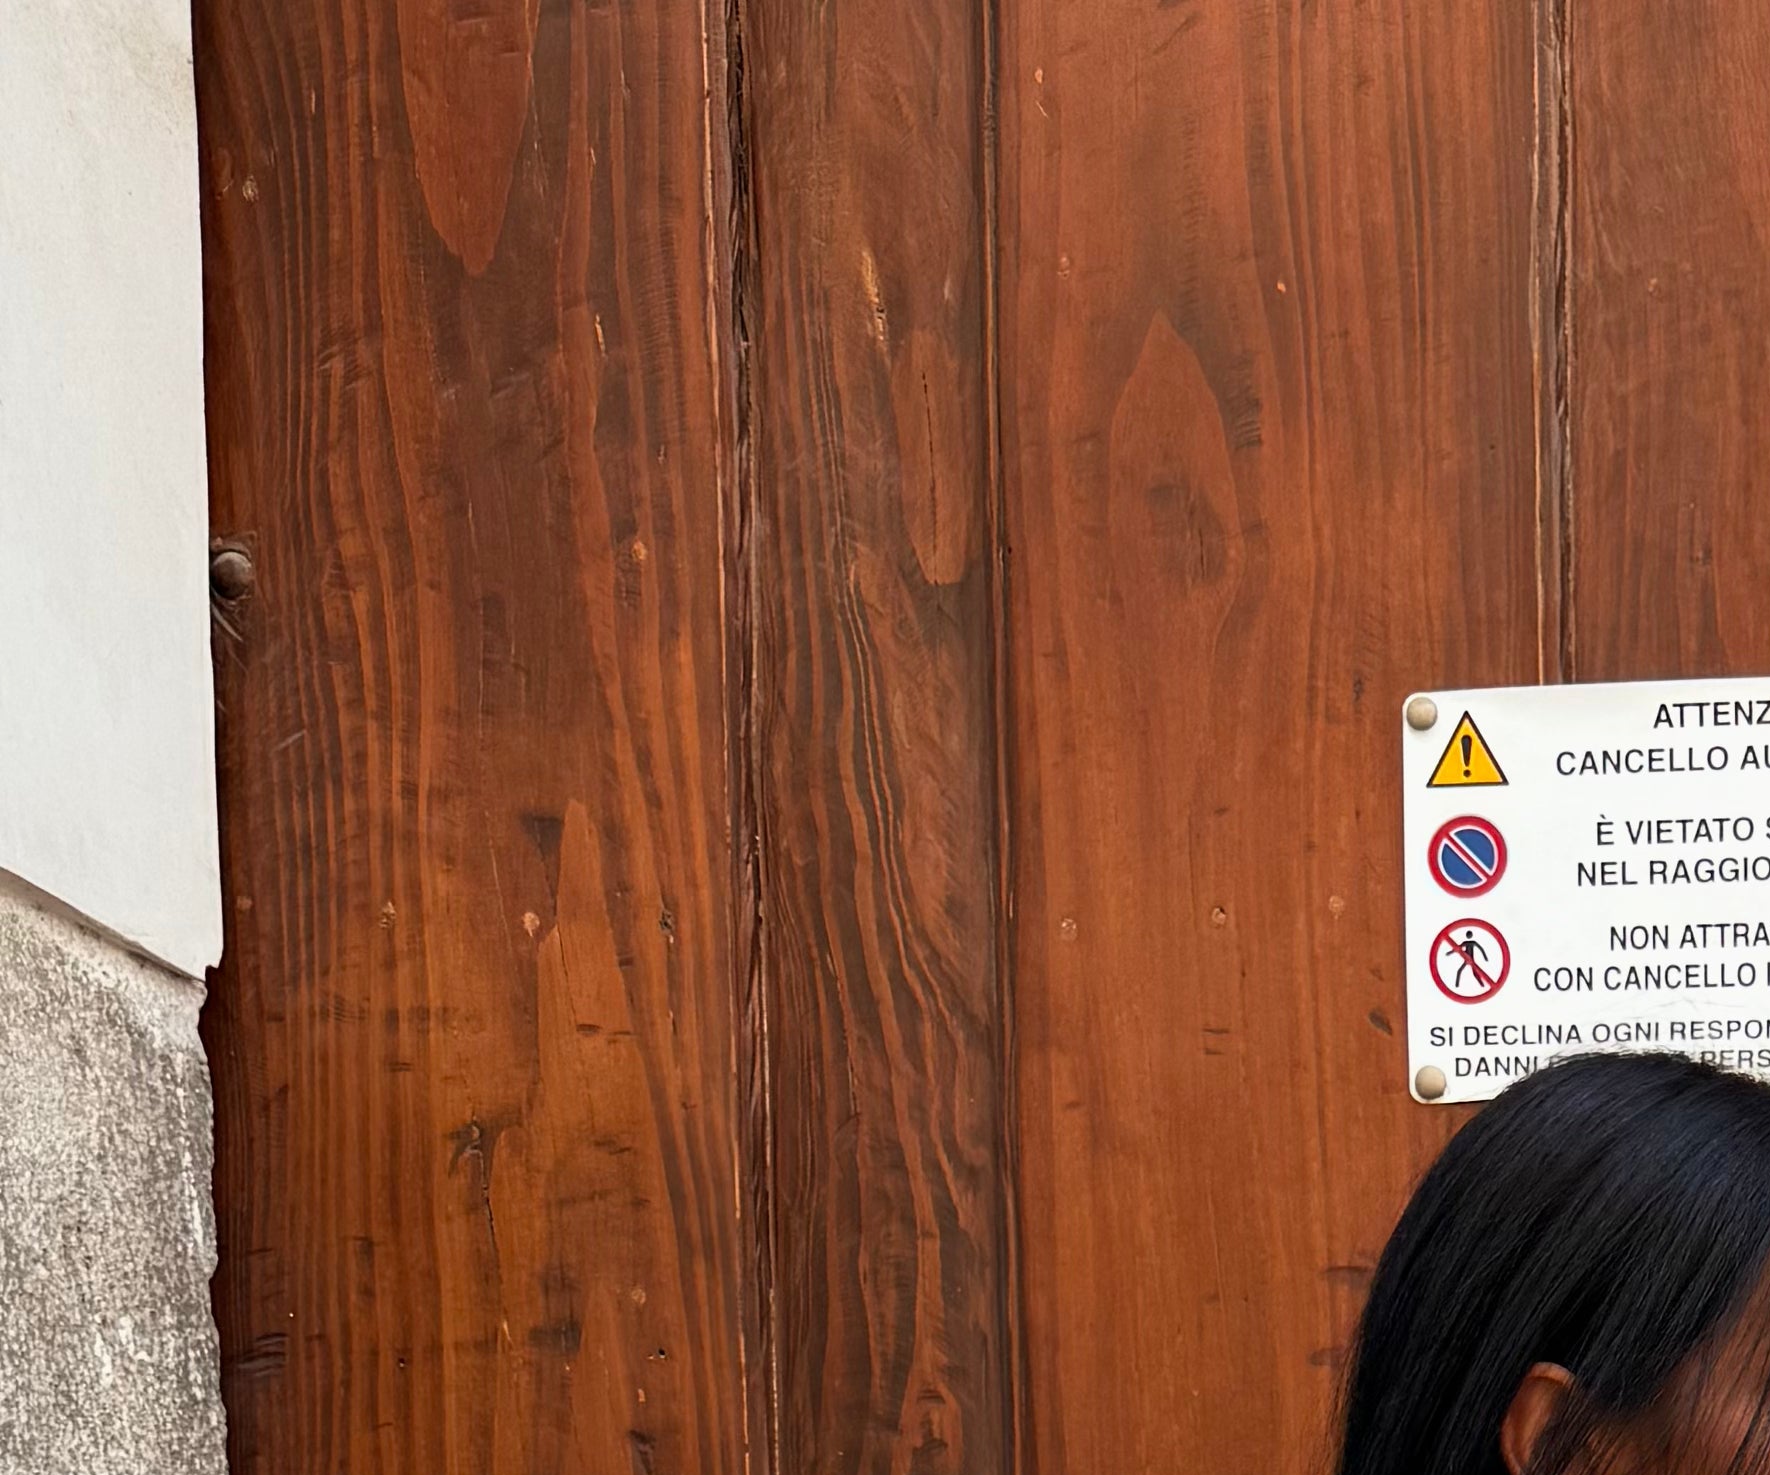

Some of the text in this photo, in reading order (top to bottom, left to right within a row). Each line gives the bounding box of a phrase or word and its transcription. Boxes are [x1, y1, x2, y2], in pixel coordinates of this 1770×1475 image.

[1556, 745, 1729, 776] CANCELLO
[1596, 814, 1614, 846] È
[1625, 816, 1754, 845] VIETATO
[1577, 861, 1638, 887] NEL
[1610, 925, 1669, 951] NON
[1533, 966, 1594, 992] CON
[1604, 962, 1756, 991] CANCELLO
[1430, 1026, 1453, 1047] SI
[1463, 1024, 1582, 1046] DECLINA
[1592, 1021, 1659, 1043] OGNI
[1455, 1055, 1538, 1077] DANNI
